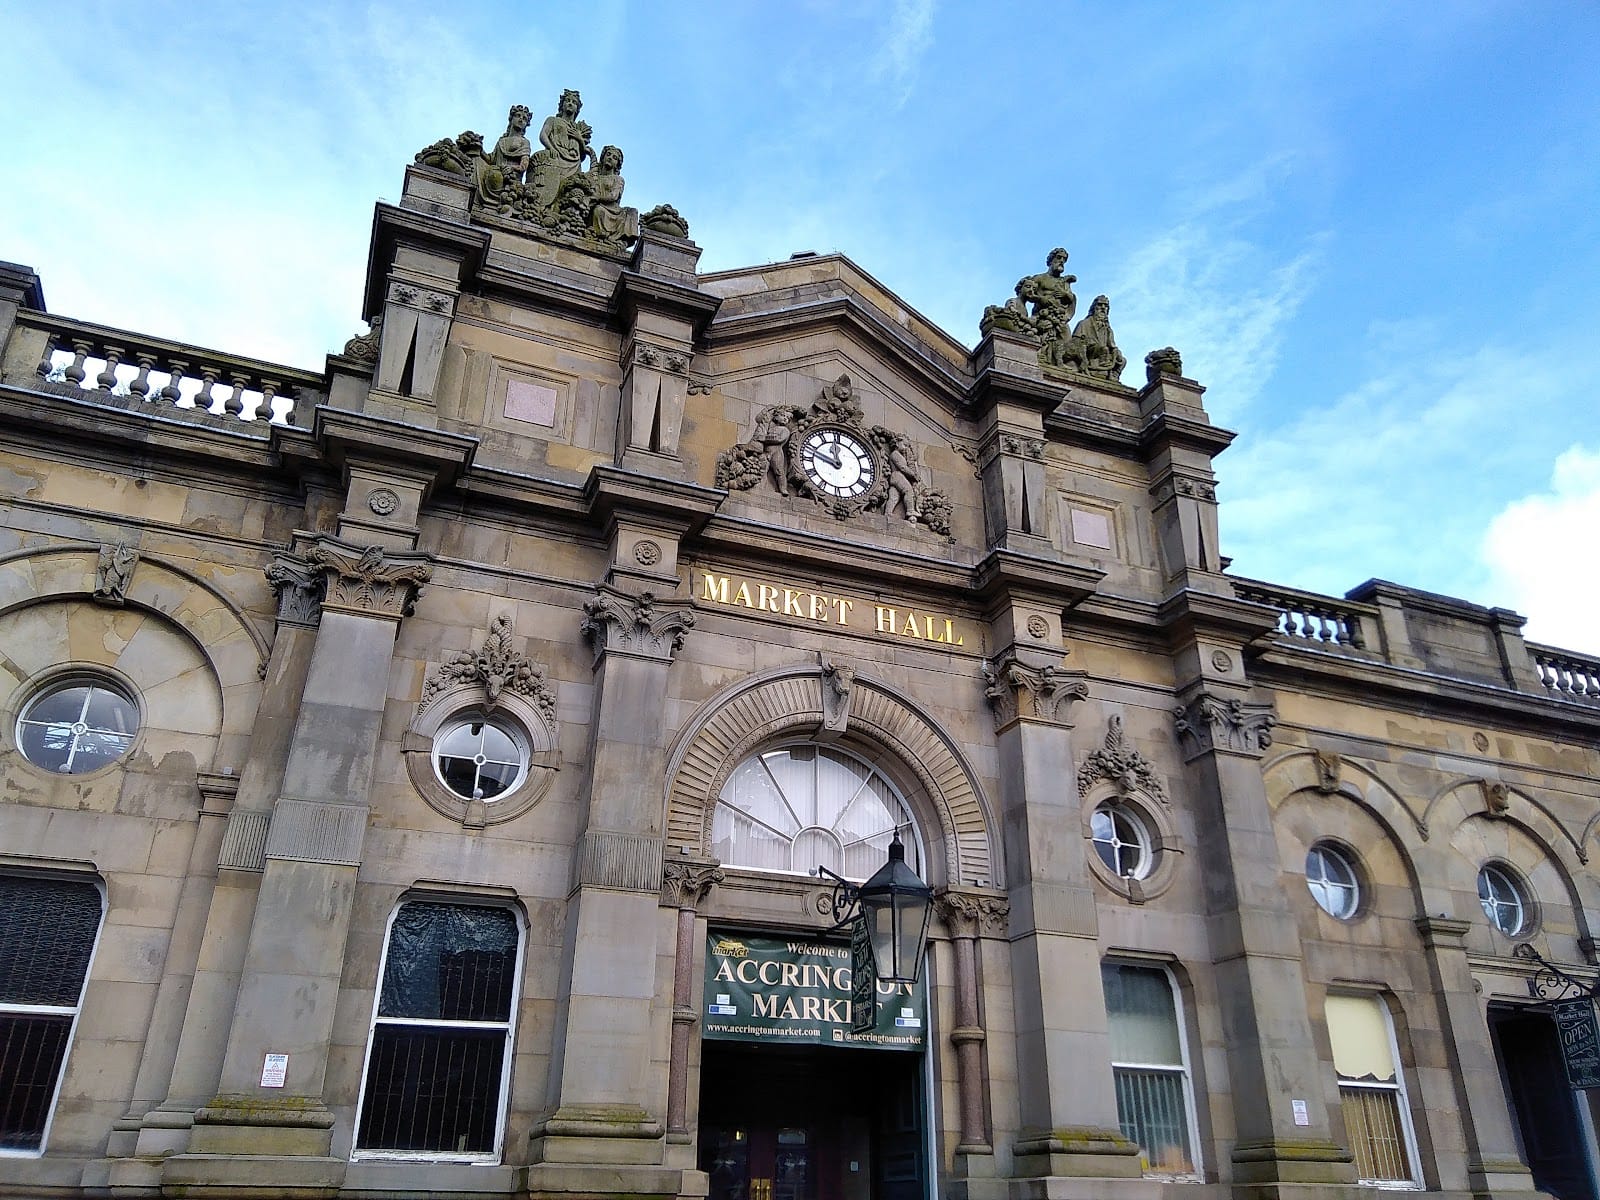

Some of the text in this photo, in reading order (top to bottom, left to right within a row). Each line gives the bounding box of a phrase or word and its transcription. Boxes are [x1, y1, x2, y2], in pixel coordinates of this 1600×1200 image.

[701, 573, 963, 646] MARKET HALL
[787, 942, 835, 958] Welcome
[837, 949, 848, 959] to
[713, 958, 914, 997] ACCRINGON
[751, 992, 883, 1026] MARK
[707, 1024, 821, 1037] www.accringtonmarket.com
[1564, 1022, 1593, 1046] OPEN
